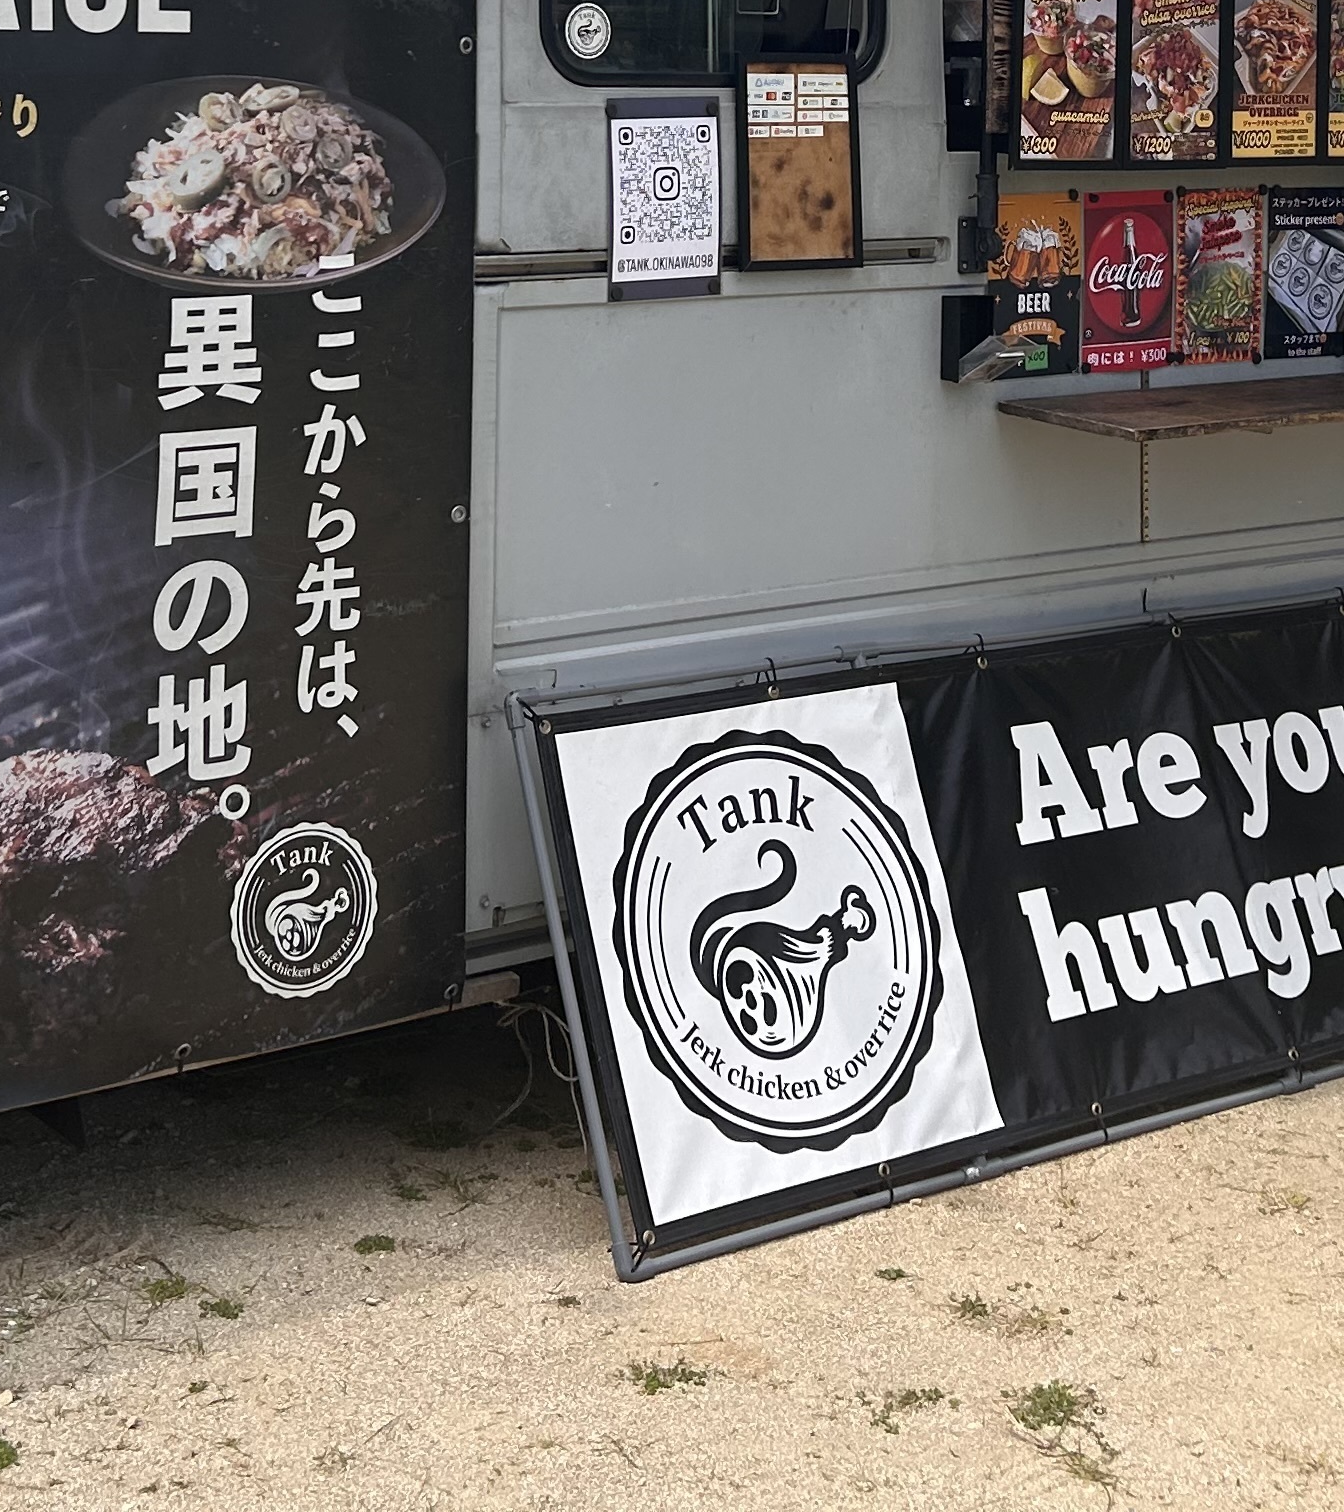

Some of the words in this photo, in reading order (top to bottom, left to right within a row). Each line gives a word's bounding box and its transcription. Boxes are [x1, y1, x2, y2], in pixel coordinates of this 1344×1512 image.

[1140, 10, 1172, 27] Salsa
[1049, 109, 1110, 126] guacamole
[1021, 137, 1057, 154] ¥300
[1133, 136, 1172, 155] ¥1200
[1232, 130, 1272, 149] ¥1000
[1274, 213, 1304, 226] Sticker
[1305, 215, 1337, 227] present
[617, 253, 714, 274] @TANK.OKINAWA098
[1088, 252, 1168, 293] Coca-Cola
[1017, 292, 1051, 314] BEER
[1011, 319, 1054, 335] FESTIVAL
[1141, 347, 1167, 363] ¥300
[294, 254, 367, 740] ここから先は、
[145, 293, 264, 822] 異国の地。
[1009, 719, 1208, 847] Are
[677, 775, 815, 853] Tank
[270, 841, 334, 876] Tank
[271, 961, 311, 978] chicken
[312, 962, 322, 974] &
[321, 948, 343, 969] over
[340, 928, 356, 952] rice
[679, 1021, 727, 1078] Jerk
[727, 1064, 823, 1101] chicken
[823, 1065, 845, 1091] &
[844, 1029, 887, 1079] over
[877, 979, 907, 1036] rice
